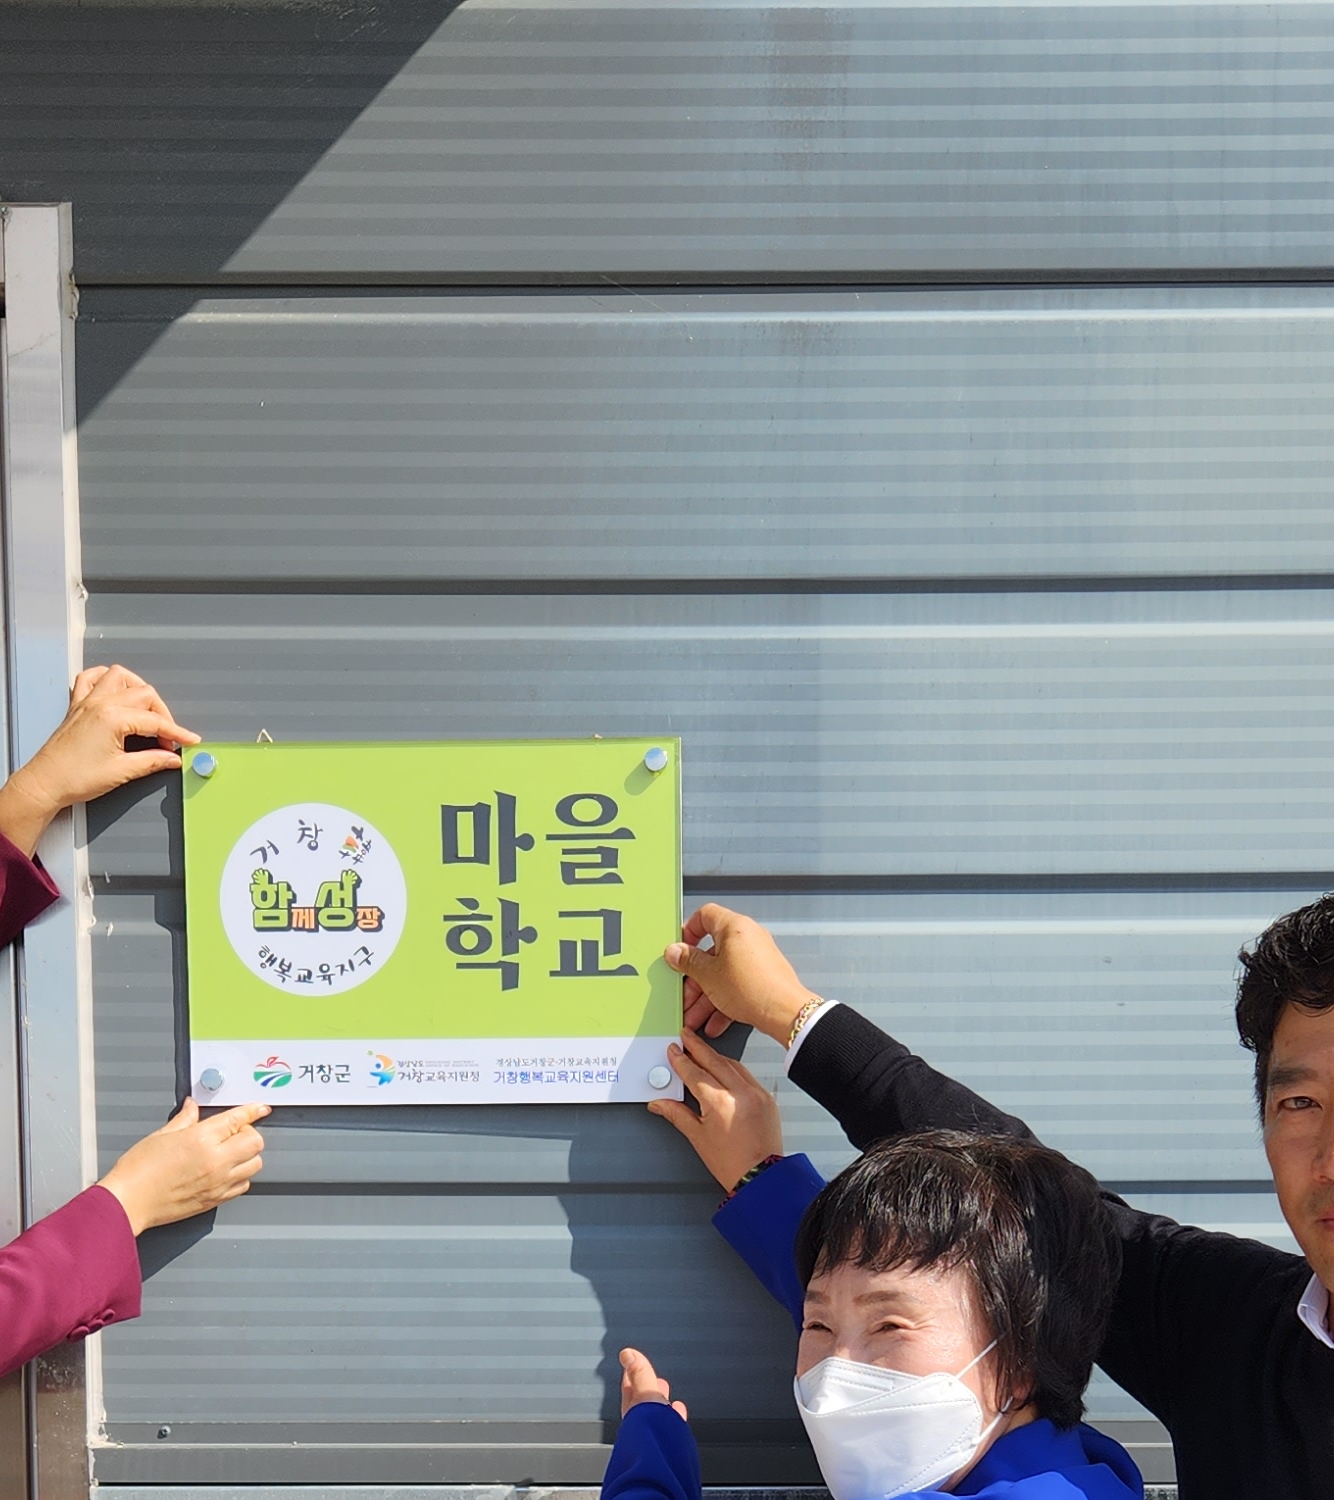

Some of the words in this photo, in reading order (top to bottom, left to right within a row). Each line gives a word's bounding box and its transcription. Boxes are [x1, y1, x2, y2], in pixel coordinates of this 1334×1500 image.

[440, 790, 636, 886] 마을
[442, 897, 639, 992] 학교
[258, 945, 375, 986] 행복교육지구
[297, 1063, 351, 1084] 거창군
[397, 1068, 480, 1084] 거창교육지원청
[493, 1070, 620, 1085] 거창행복교육지원센터
